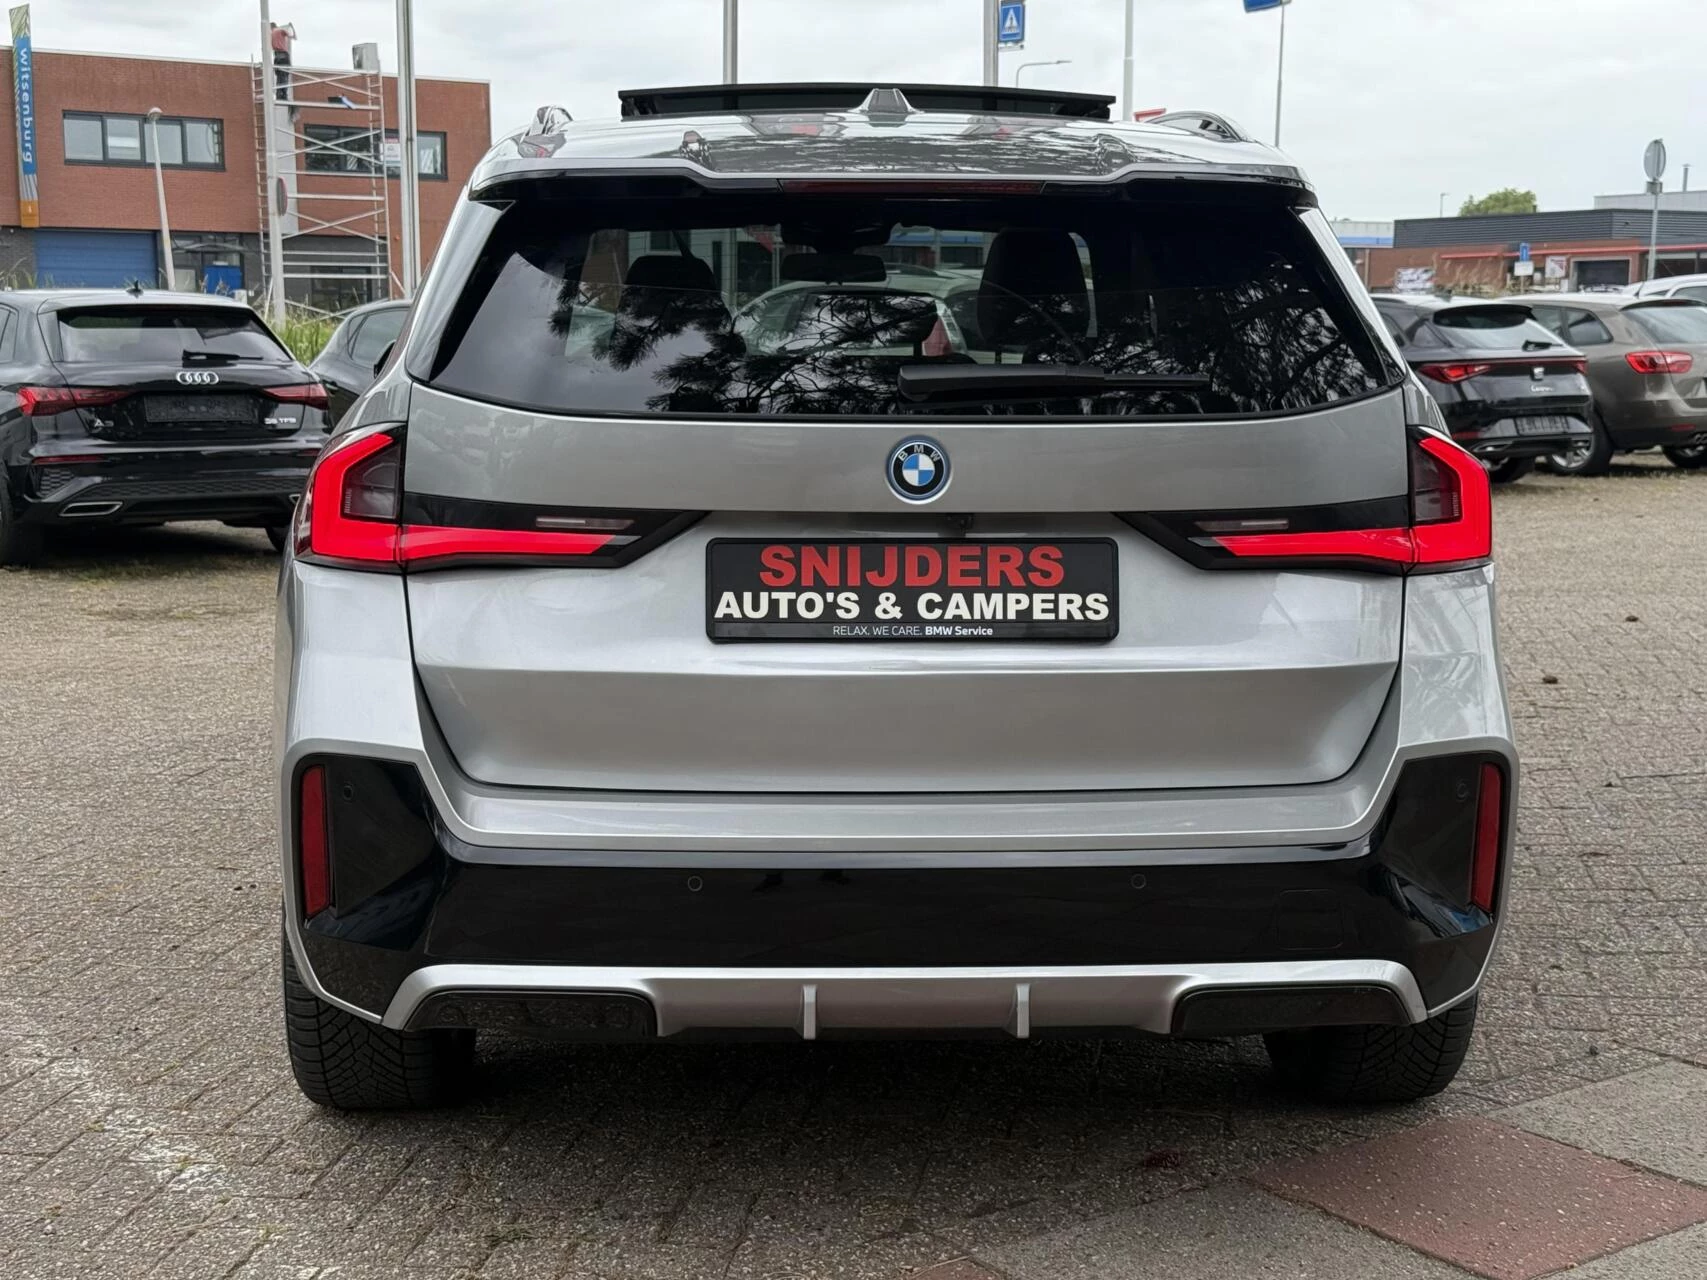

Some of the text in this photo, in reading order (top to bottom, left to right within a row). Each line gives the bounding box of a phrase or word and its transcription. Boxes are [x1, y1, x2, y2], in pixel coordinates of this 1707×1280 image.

[19, 48, 33, 164] witsenburg
[897, 444, 941, 462] BMW
[759, 545, 1065, 587] SNIJDERS
[713, 591, 1109, 621] AUTO'S & CAMPERS
[832, 625, 993, 636] RELAX. WE CARE. BMW Service
